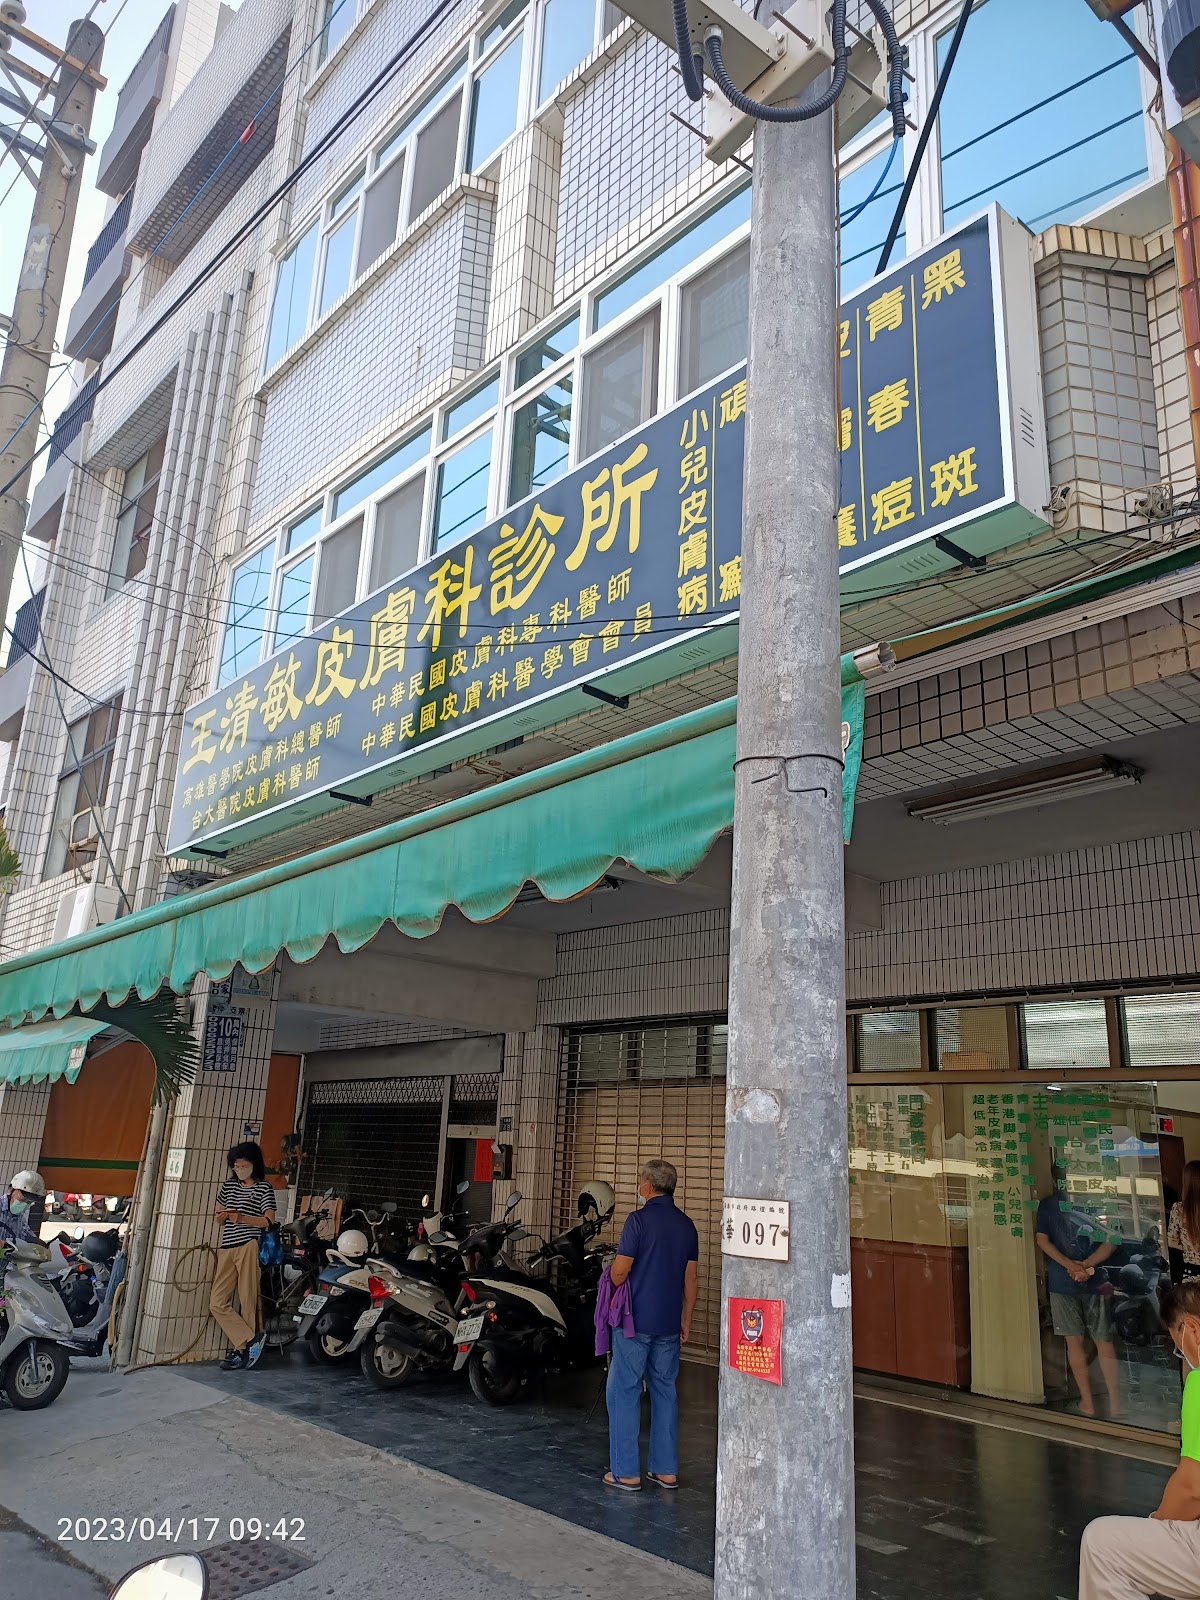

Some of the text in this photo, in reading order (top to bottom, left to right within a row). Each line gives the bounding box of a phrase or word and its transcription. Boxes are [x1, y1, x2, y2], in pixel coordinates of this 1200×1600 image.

[865, 285, 915, 534] 青春痘
[922, 248, 978, 507] 黑斑
[677, 408, 709, 620] 小兒皮膚病
[182, 442, 659, 775] 王清敏皮膚科診所
[361, 601, 653, 757] 中華民國皮膚科醫學會會員
[371, 567, 633, 717] 中華民國皮膚科專科醫師
[182, 713, 343, 808] 高雄醫學院皮膚科總醫師
[191, 756, 321, 831] 台大醫院皮膚科醫師
[743, 1222, 780, 1246] 097
